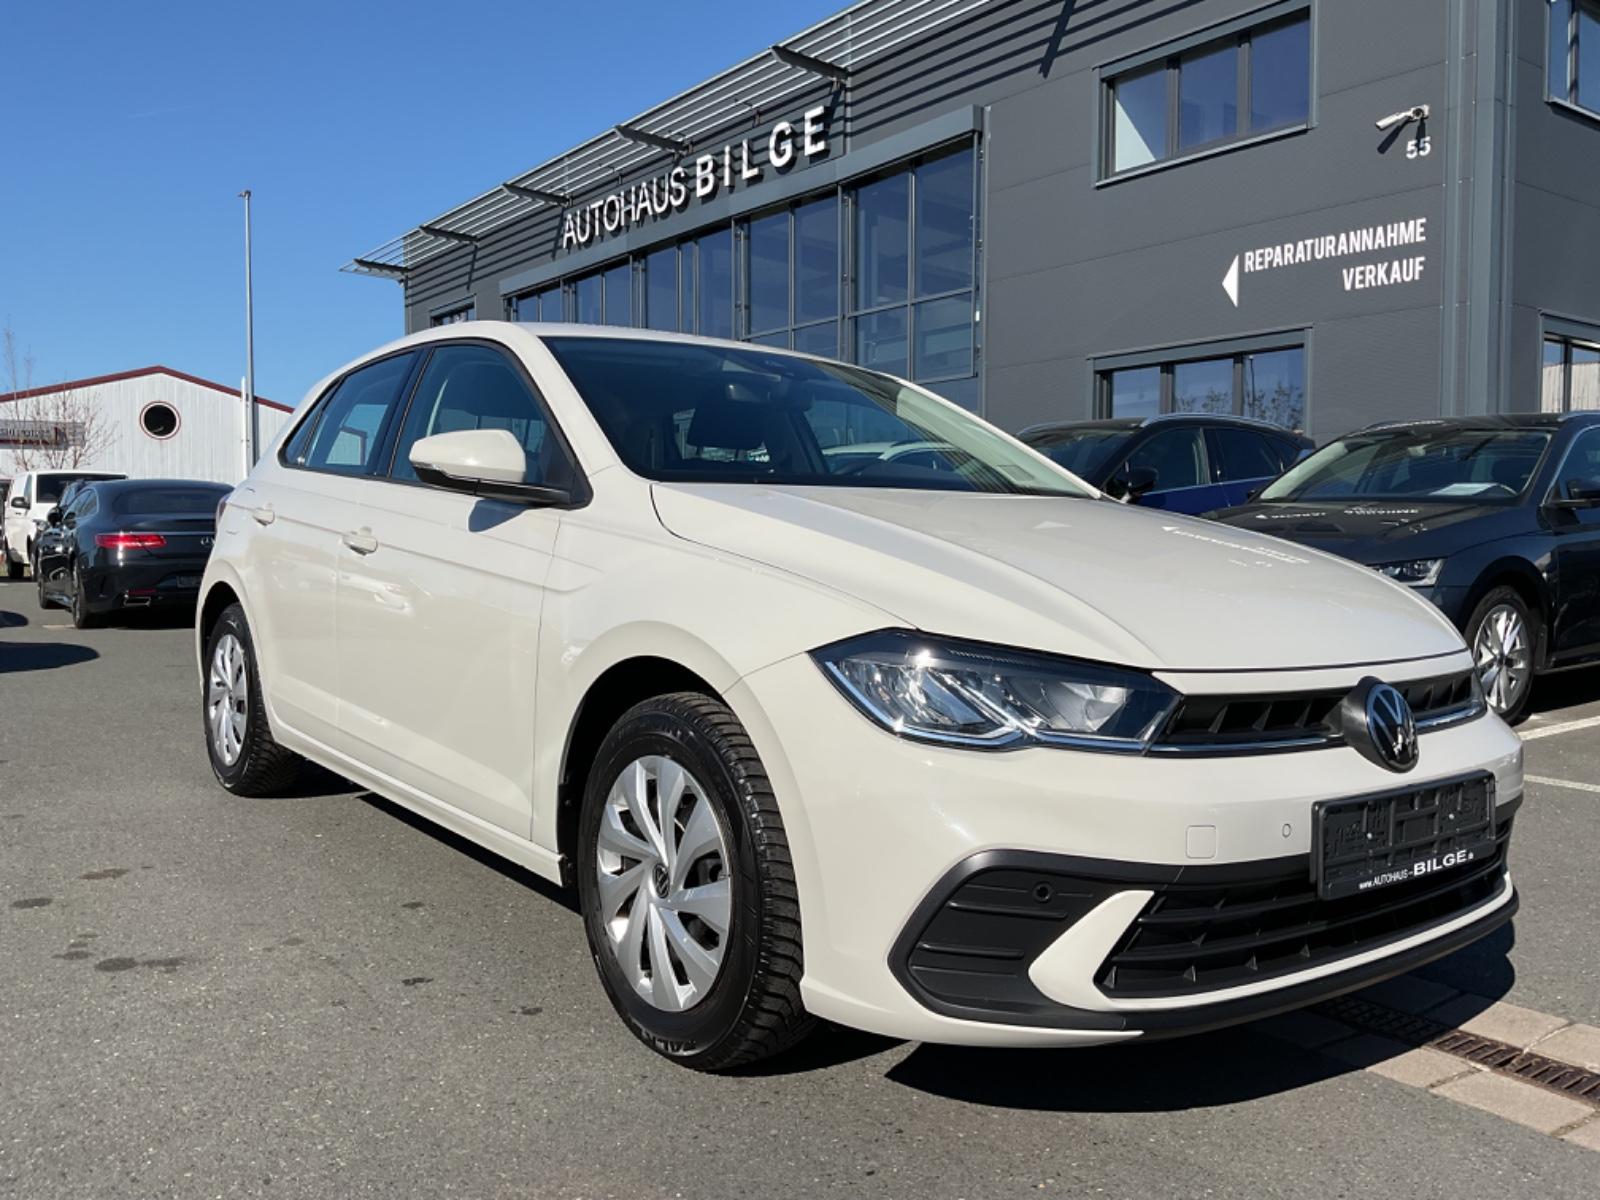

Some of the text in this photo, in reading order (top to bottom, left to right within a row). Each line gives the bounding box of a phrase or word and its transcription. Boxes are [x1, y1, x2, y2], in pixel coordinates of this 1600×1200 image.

[1406, 137, 1431, 159] 55
[563, 105, 825, 248] AUTOHAUS BILGE
[1244, 218, 1427, 272] REPARATURANNAHME
[1342, 257, 1426, 291] VERKAUF
